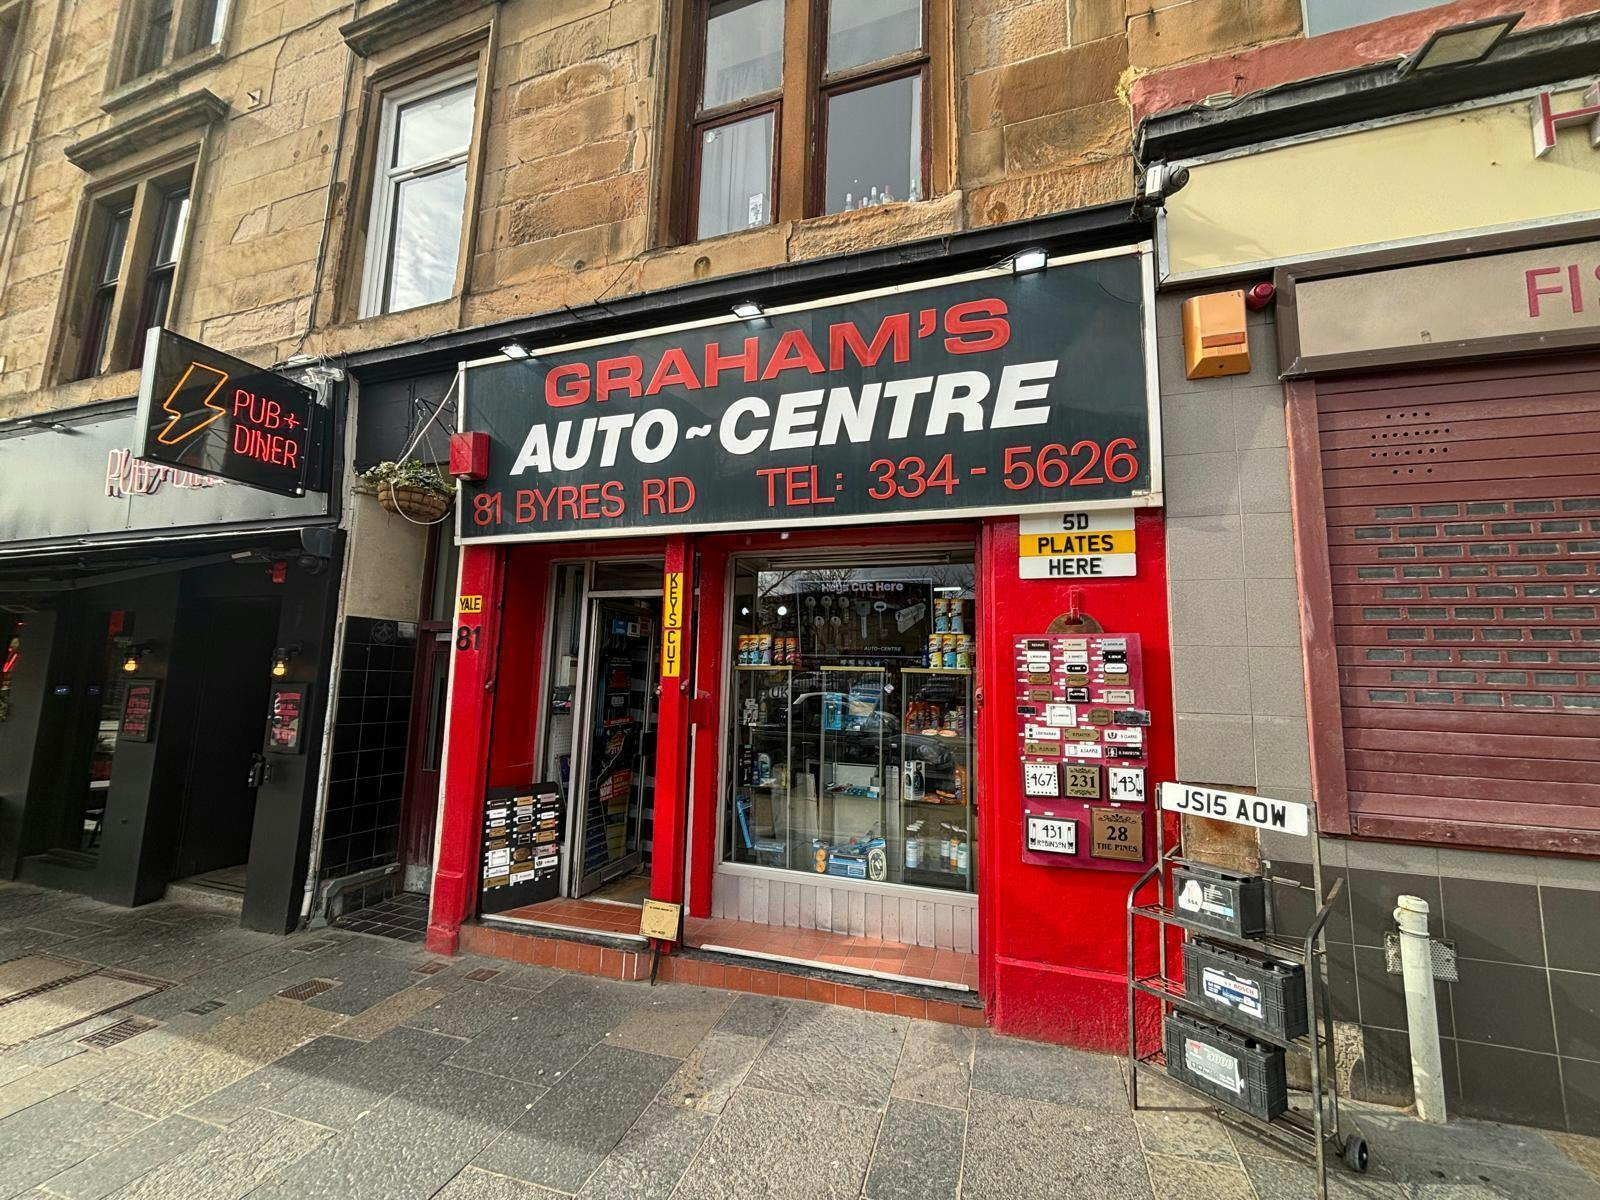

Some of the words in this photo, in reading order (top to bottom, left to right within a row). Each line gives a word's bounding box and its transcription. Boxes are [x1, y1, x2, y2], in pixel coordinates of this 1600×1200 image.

[545, 298, 1011, 408] GRAHAM'S
[233, 424, 298, 469] DINER
[473, 491, 502, 526] 81
[516, 480, 625, 524] BYRES
[642, 476, 697, 516] RD
[1062, 513, 1089, 531] 5D
[1037, 534, 1114, 554] PLATES
[1049, 557, 1103, 576] HERE
[851, 582, 875, 592] Cut
[876, 582, 904, 592] Here
[459, 597, 481, 611] YALE
[669, 572, 679, 627] KEYS
[456, 625, 481, 651] 81
[667, 630, 677, 674] CUT
[1030, 773, 1054, 787] 467
[1070, 774, 1096, 788] 231
[1118, 776, 1136, 793] 43
[1176, 789, 1227, 816] JS15
[1236, 799, 1286, 828] AOW
[1041, 824, 1062, 840] 431
[1106, 826, 1128, 842] 28
[1096, 842, 1112, 851] THE
[1115, 844, 1138, 852] PINES
[1233, 982, 1254, 996] BOSCH
